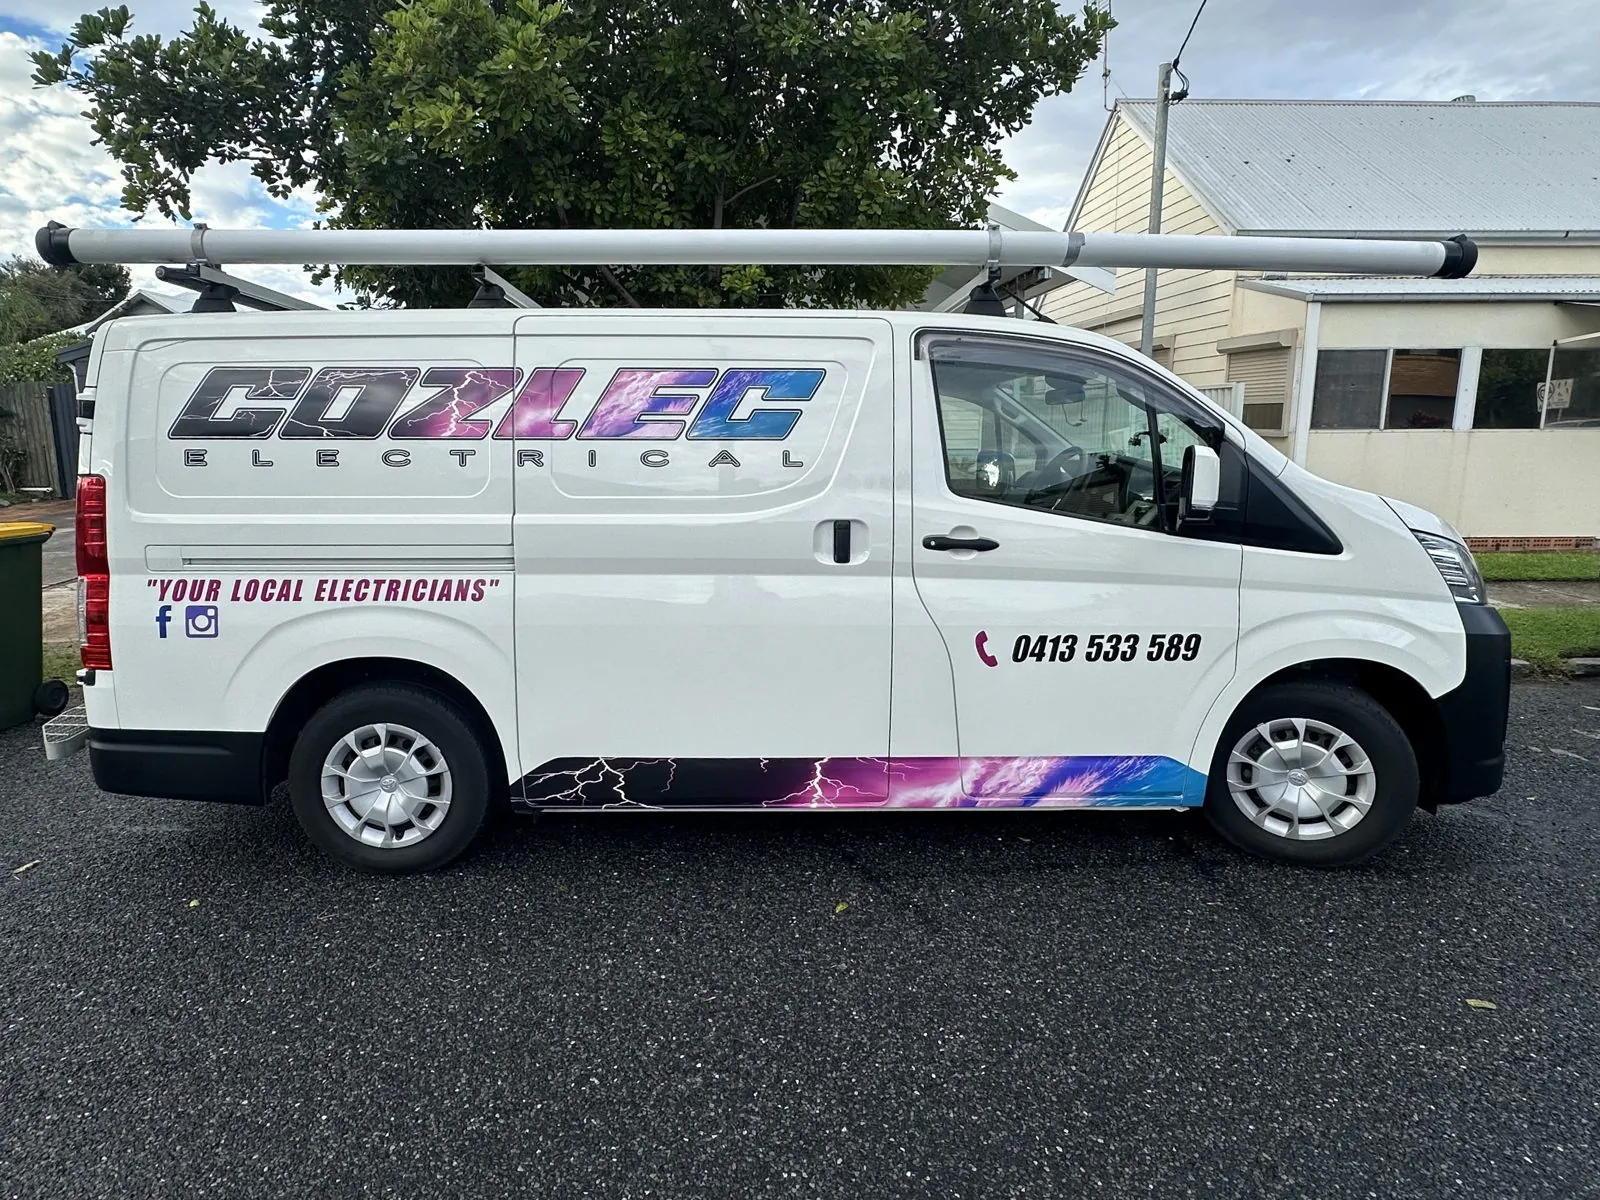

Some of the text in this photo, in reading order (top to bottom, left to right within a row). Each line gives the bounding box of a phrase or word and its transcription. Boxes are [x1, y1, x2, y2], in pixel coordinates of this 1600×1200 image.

[168, 366, 826, 441] COZLEC
[184, 449, 803, 467] ELECTRICAL
[147, 579, 500, 602] "YOUR LOCAL ELECTRICIANS"
[1011, 633, 1201, 662] 0413 533 589
